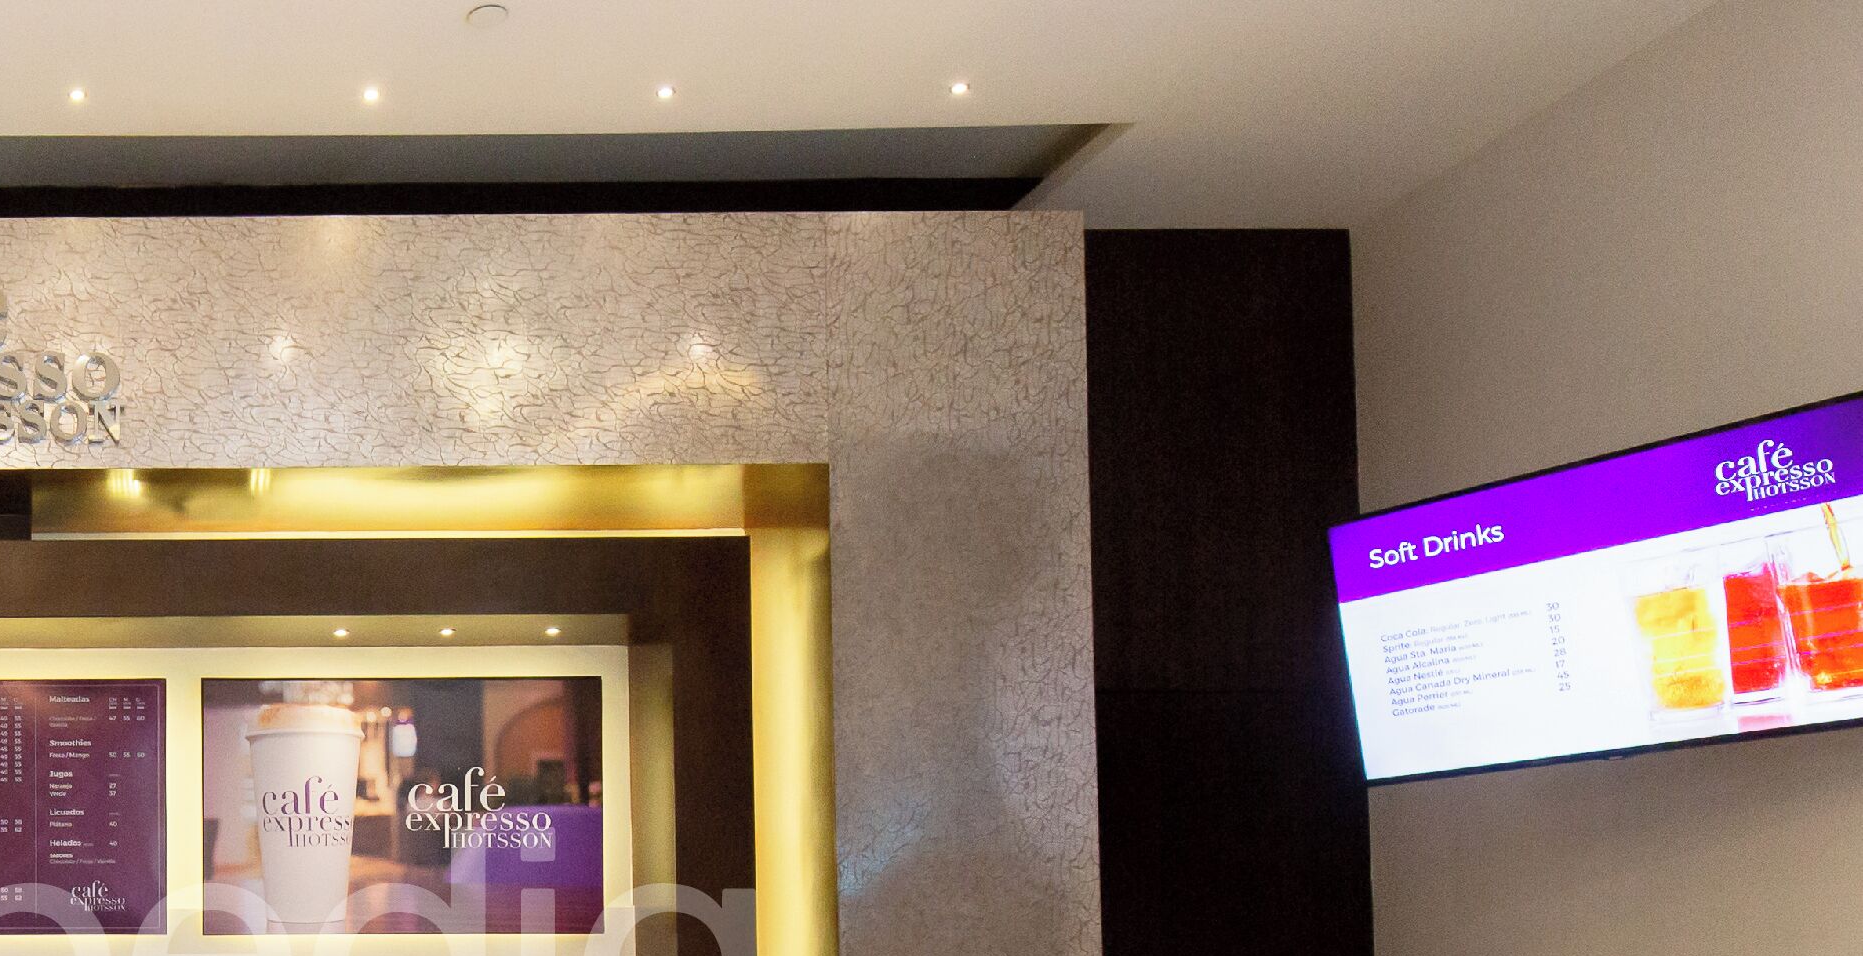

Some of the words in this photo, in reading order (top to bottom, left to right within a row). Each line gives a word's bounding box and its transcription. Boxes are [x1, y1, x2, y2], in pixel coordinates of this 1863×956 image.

[1715, 439, 1793, 482] café
[1715, 458, 1834, 501] expresso
[1753, 472, 1836, 500] HOTSSON
[1369, 541, 1418, 568] Soft
[1422, 523, 1504, 556] Drinks
[1380, 633, 1404, 642] Coca
[1546, 602, 1559, 611] 30
[1548, 613, 1561, 622] 30
[1384, 654, 1408, 664] Agua
[1550, 625, 1560, 634] 15
[1386, 665, 1410, 674] Agua
[1412, 657, 1450, 669] Alcalina
[1552, 636, 1565, 645] 20
[1388, 676, 1411, 685] Agua
[1554, 648, 1567, 657] 28
[1389, 687, 1413, 696] Agua
[1415, 678, 1451, 691] Canada
[1453, 676, 1470, 685] Dry
[1473, 668, 1510, 681] Mineral
[1555, 659, 1565, 669] 17
[1391, 697, 1415, 706] Agua
[1557, 671, 1570, 680] 45
[1392, 704, 1435, 717] Gatorade
[1559, 682, 1571, 692] 25
[49, 770, 73, 778] Jugos
[407, 766, 506, 813] café
[49, 808, 84, 816] Licuados
[262, 774, 339, 815] café
[262, 814, 353, 848] express
[405, 810, 552, 848] expresso
[450, 832, 554, 849] HOTSSON
[70, 897, 125, 911] expresso
[71, 880, 109, 898] café
